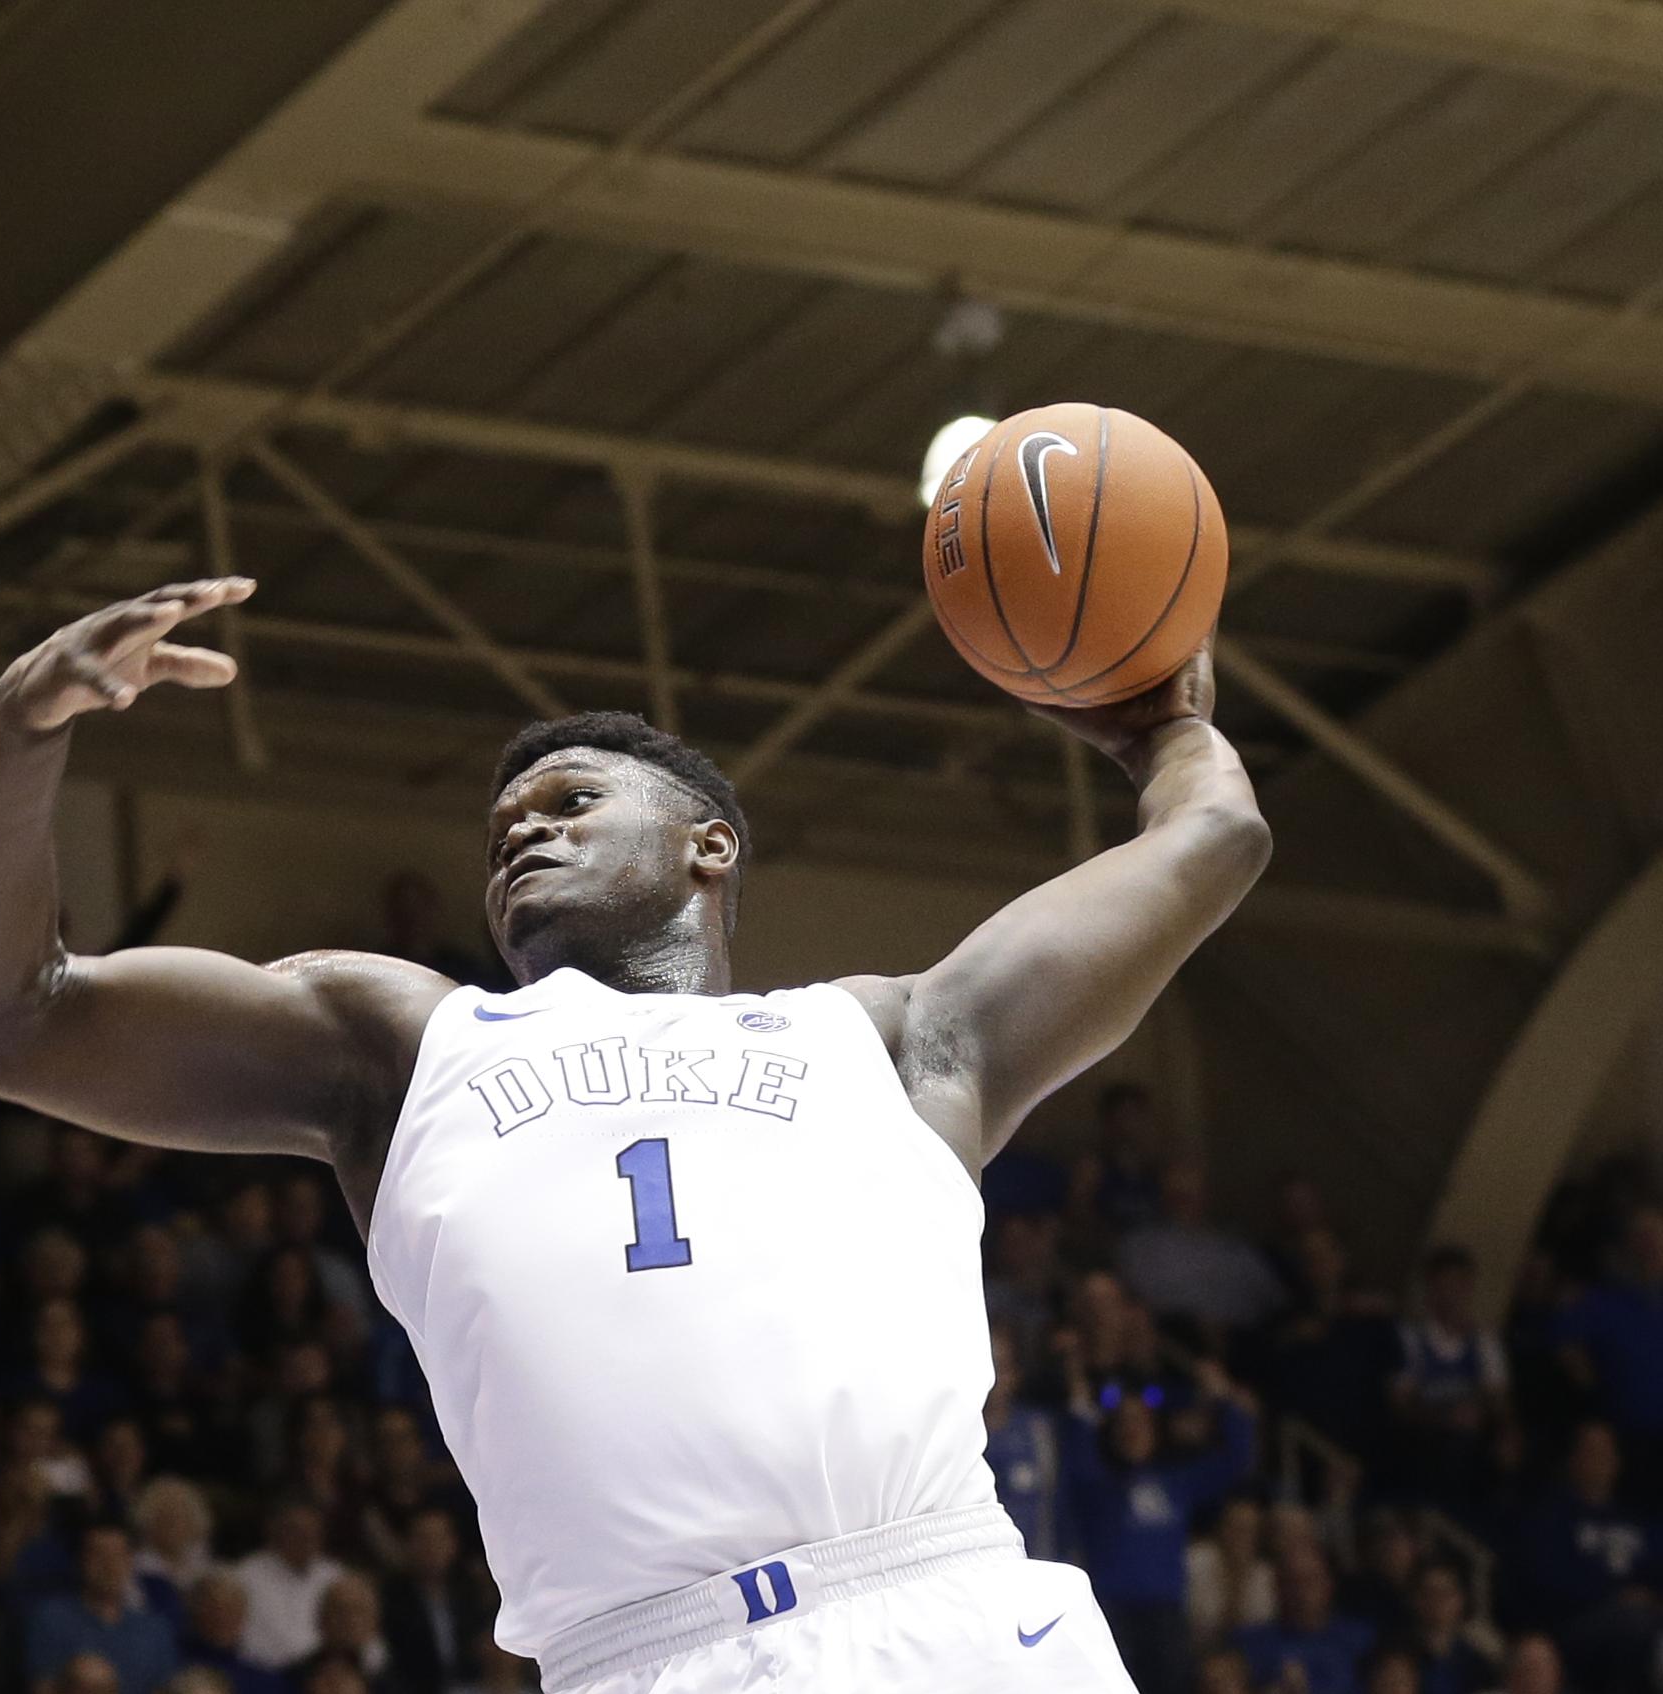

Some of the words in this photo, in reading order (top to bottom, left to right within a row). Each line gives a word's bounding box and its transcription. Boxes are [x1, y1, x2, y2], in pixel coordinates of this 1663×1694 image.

[467, 1035, 809, 1139] DUKE
[615, 1137, 693, 1273] 1
[729, 1560, 798, 1625] D
